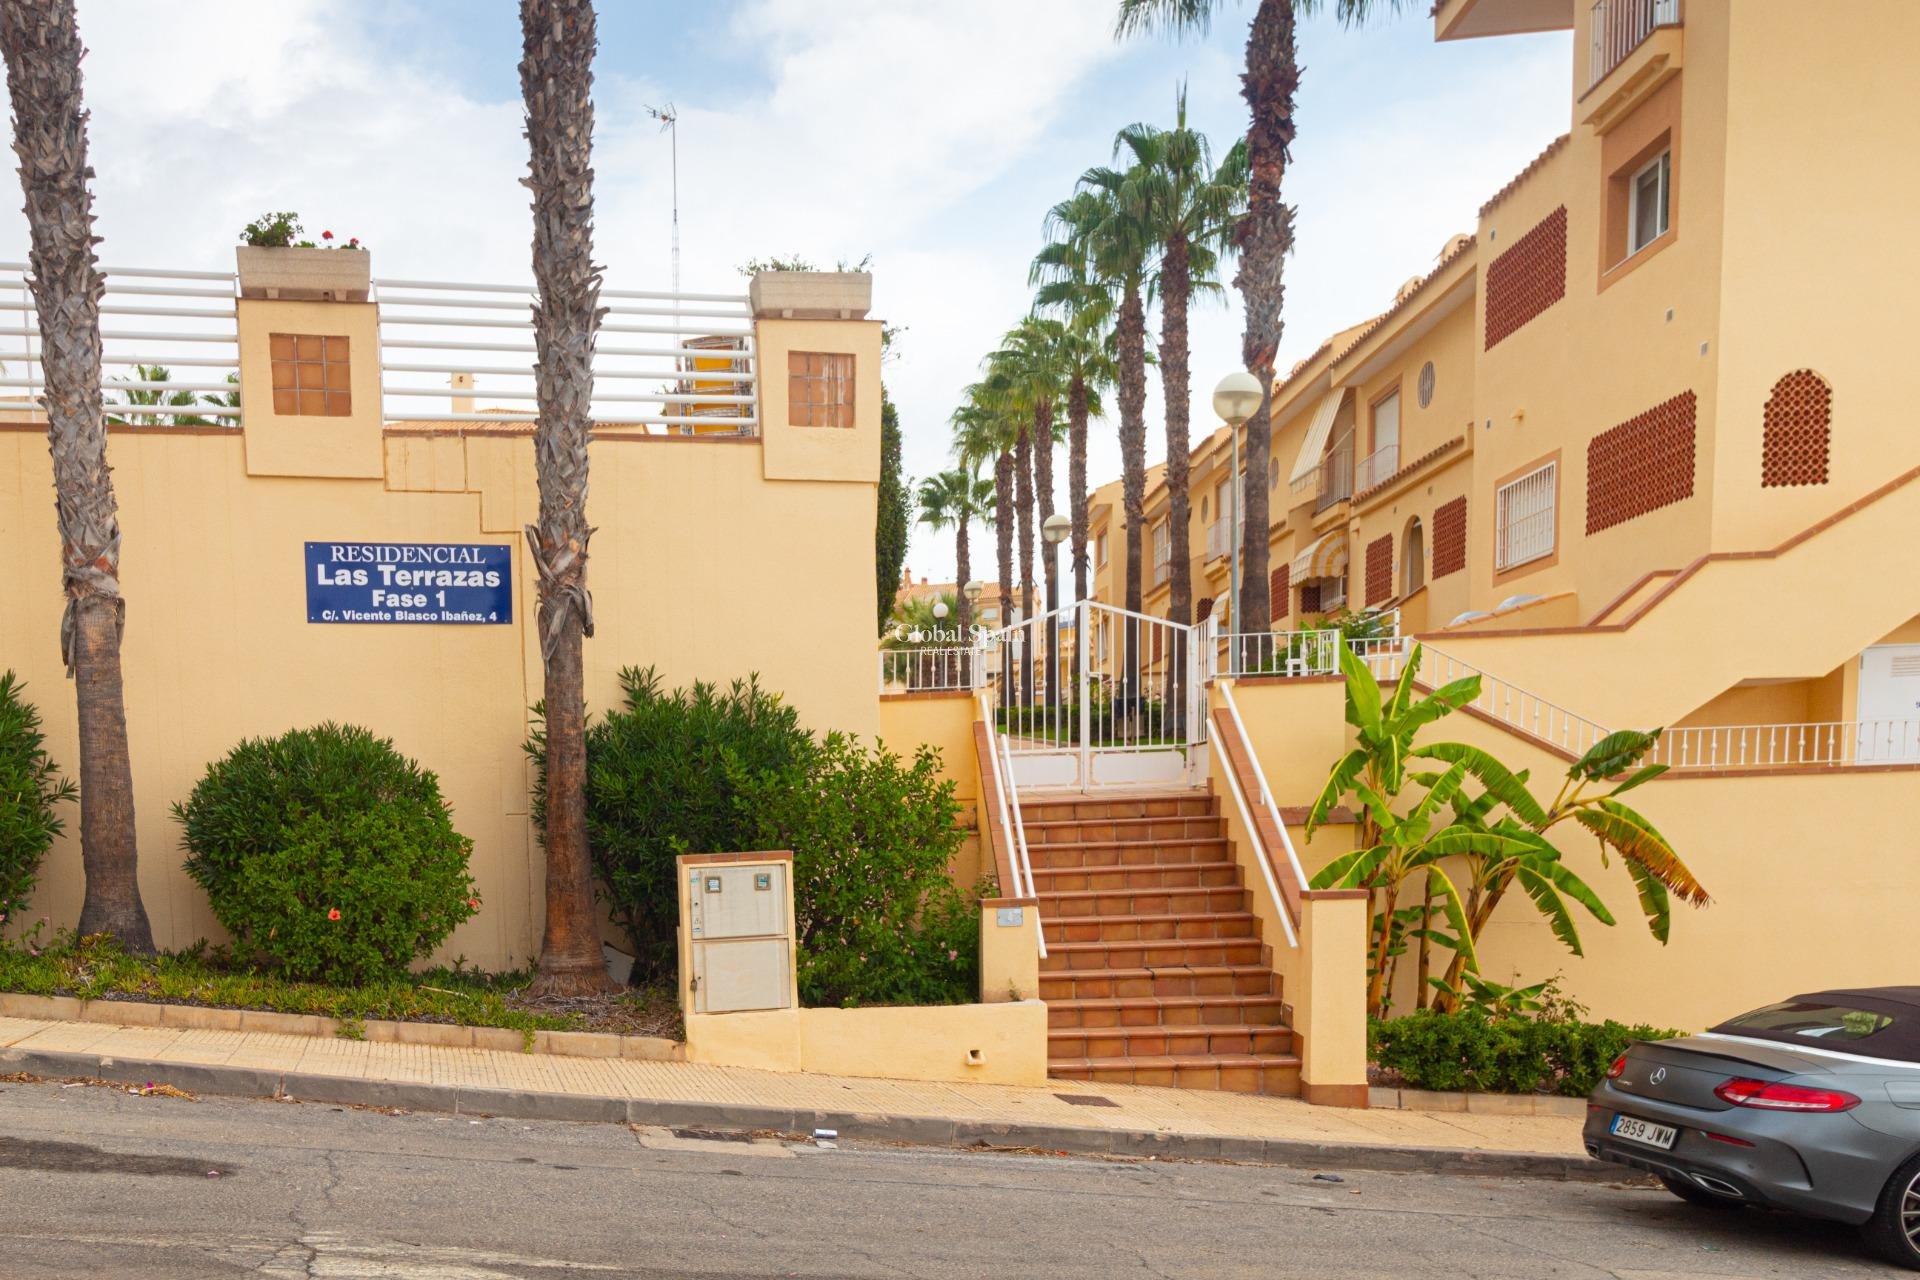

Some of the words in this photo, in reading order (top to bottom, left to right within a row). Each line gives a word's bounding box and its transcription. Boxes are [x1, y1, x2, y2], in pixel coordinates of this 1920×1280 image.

[330, 545, 486, 564] RESIDENCIAL
[317, 563, 369, 586] Las
[377, 564, 501, 587] Terrazas
[372, 589, 427, 607] Fase
[435, 589, 446, 607] 1
[342, 611, 391, 621] Vicente
[395, 611, 438, 622] Blasco
[441, 611, 486, 623] Ibañez,
[489, 612, 497, 622] 4
[1616, 1119, 1645, 1137] 2859
[1647, 1126, 1673, 1144] JWM
